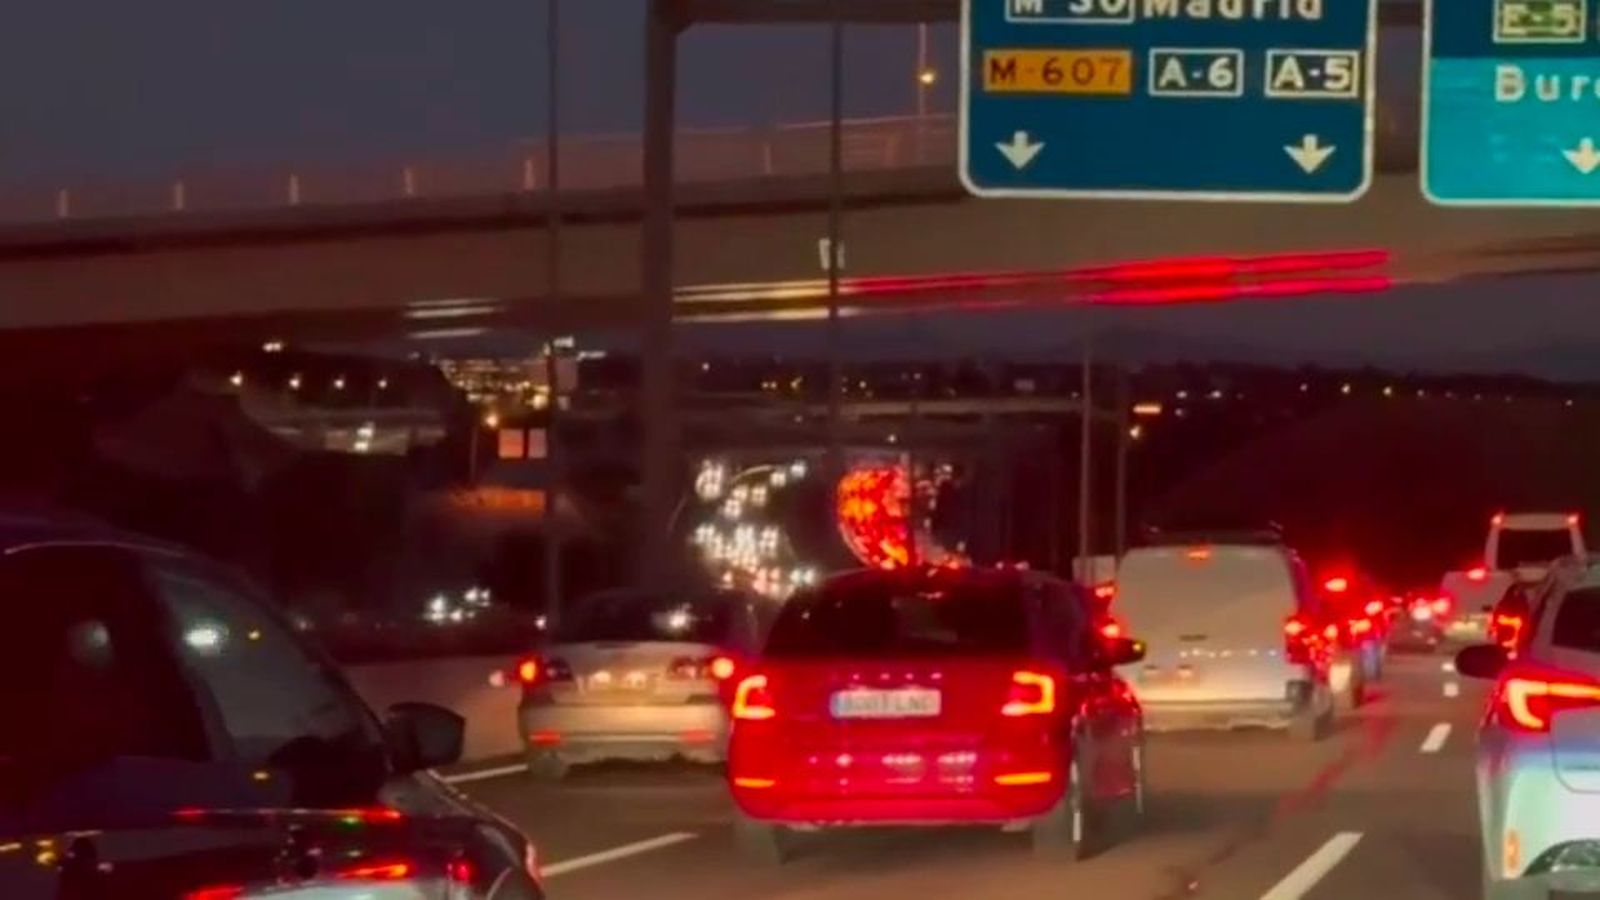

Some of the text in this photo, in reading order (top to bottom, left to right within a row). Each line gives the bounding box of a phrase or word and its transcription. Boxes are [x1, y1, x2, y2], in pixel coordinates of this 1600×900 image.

[1143, 0, 1322, 19] Madrid
[1502, 4, 1577, 35] E-5
[989, 56, 1354, 90] M-607 A-6 A-5
[1495, 64, 1600, 101] Bur
